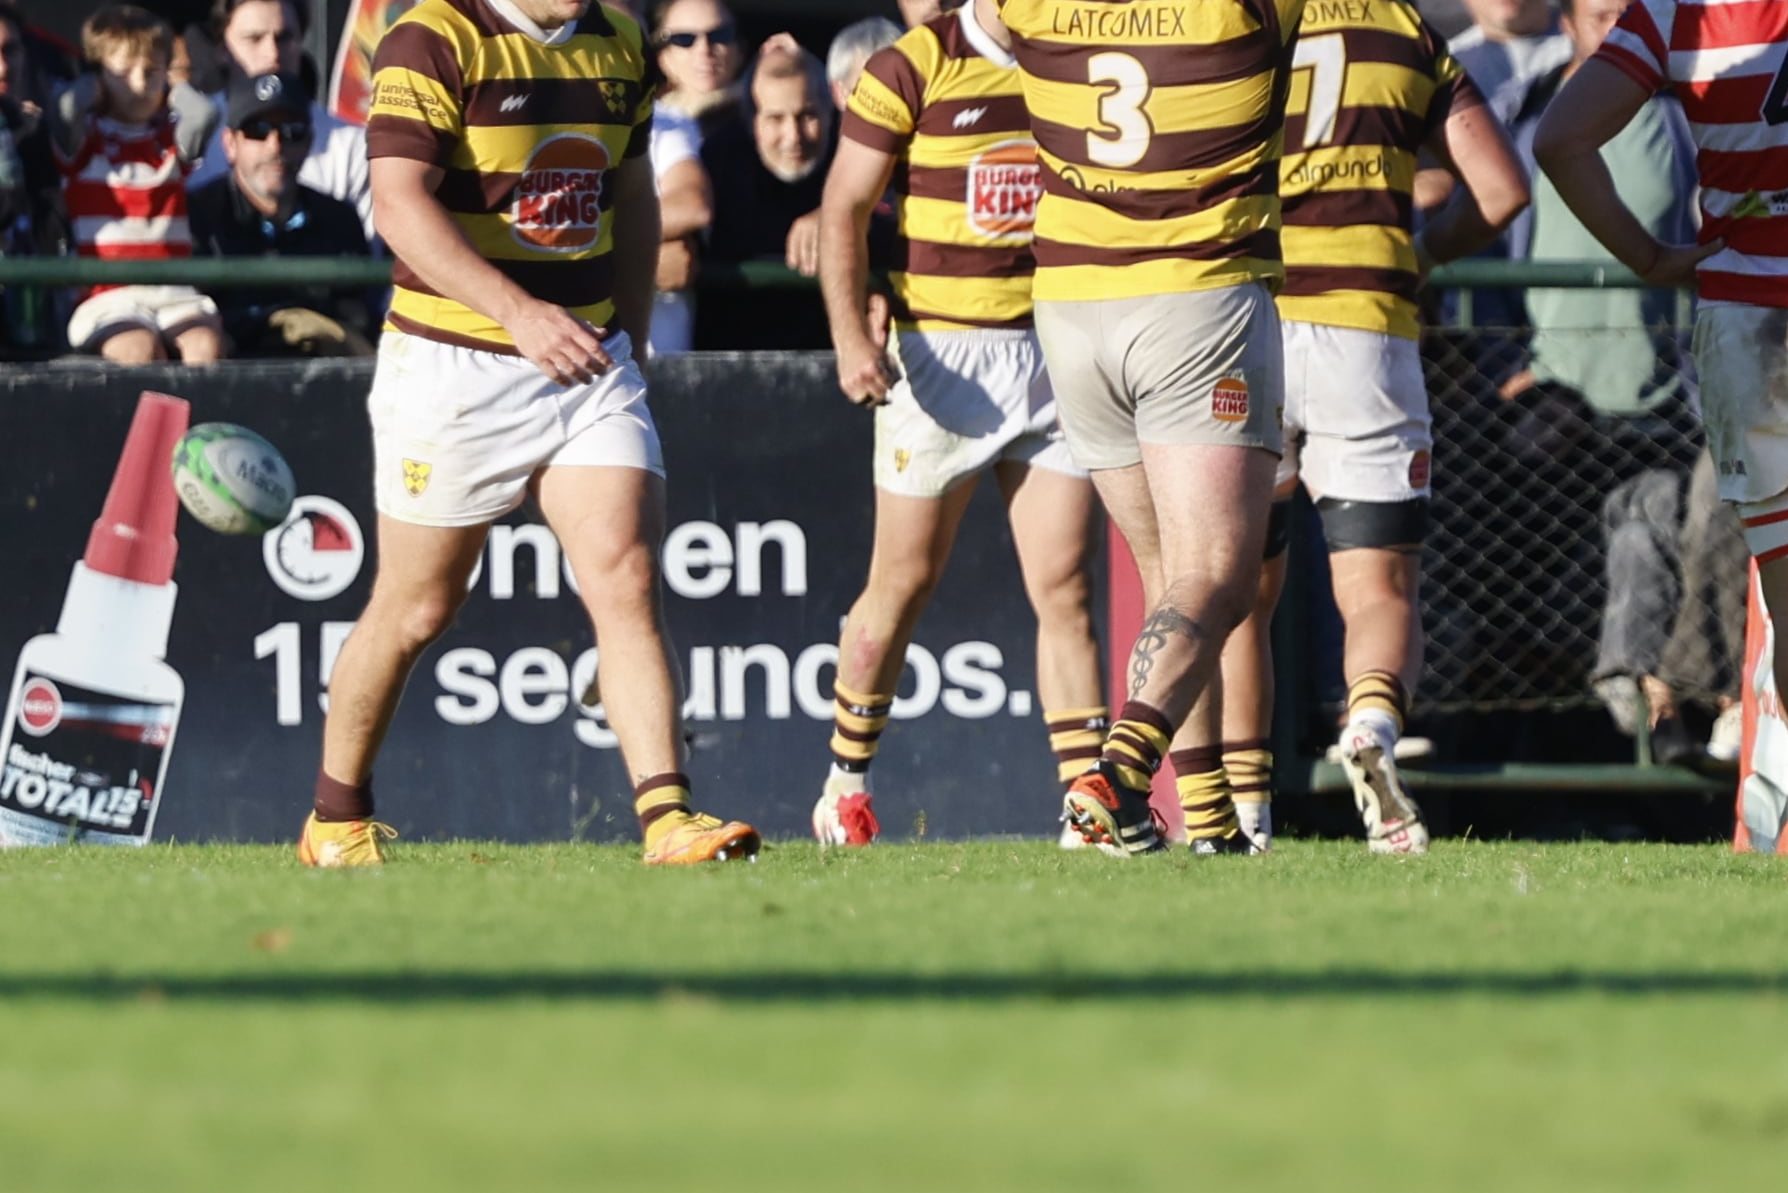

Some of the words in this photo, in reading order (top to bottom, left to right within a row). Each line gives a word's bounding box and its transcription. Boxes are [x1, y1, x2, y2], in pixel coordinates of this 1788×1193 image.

[1052, 6, 1187, 39] LATCOMEX
[1291, 32, 1346, 149] 7
[1086, 52, 1152, 168] 3
[974, 166, 1045, 187] BURGE
[518, 193, 600, 226] KING
[974, 186, 1036, 216] KIN
[1212, 399, 1248, 414] KING
[662, 520, 808, 599] en
[0, 764, 112, 826] TOTAL
